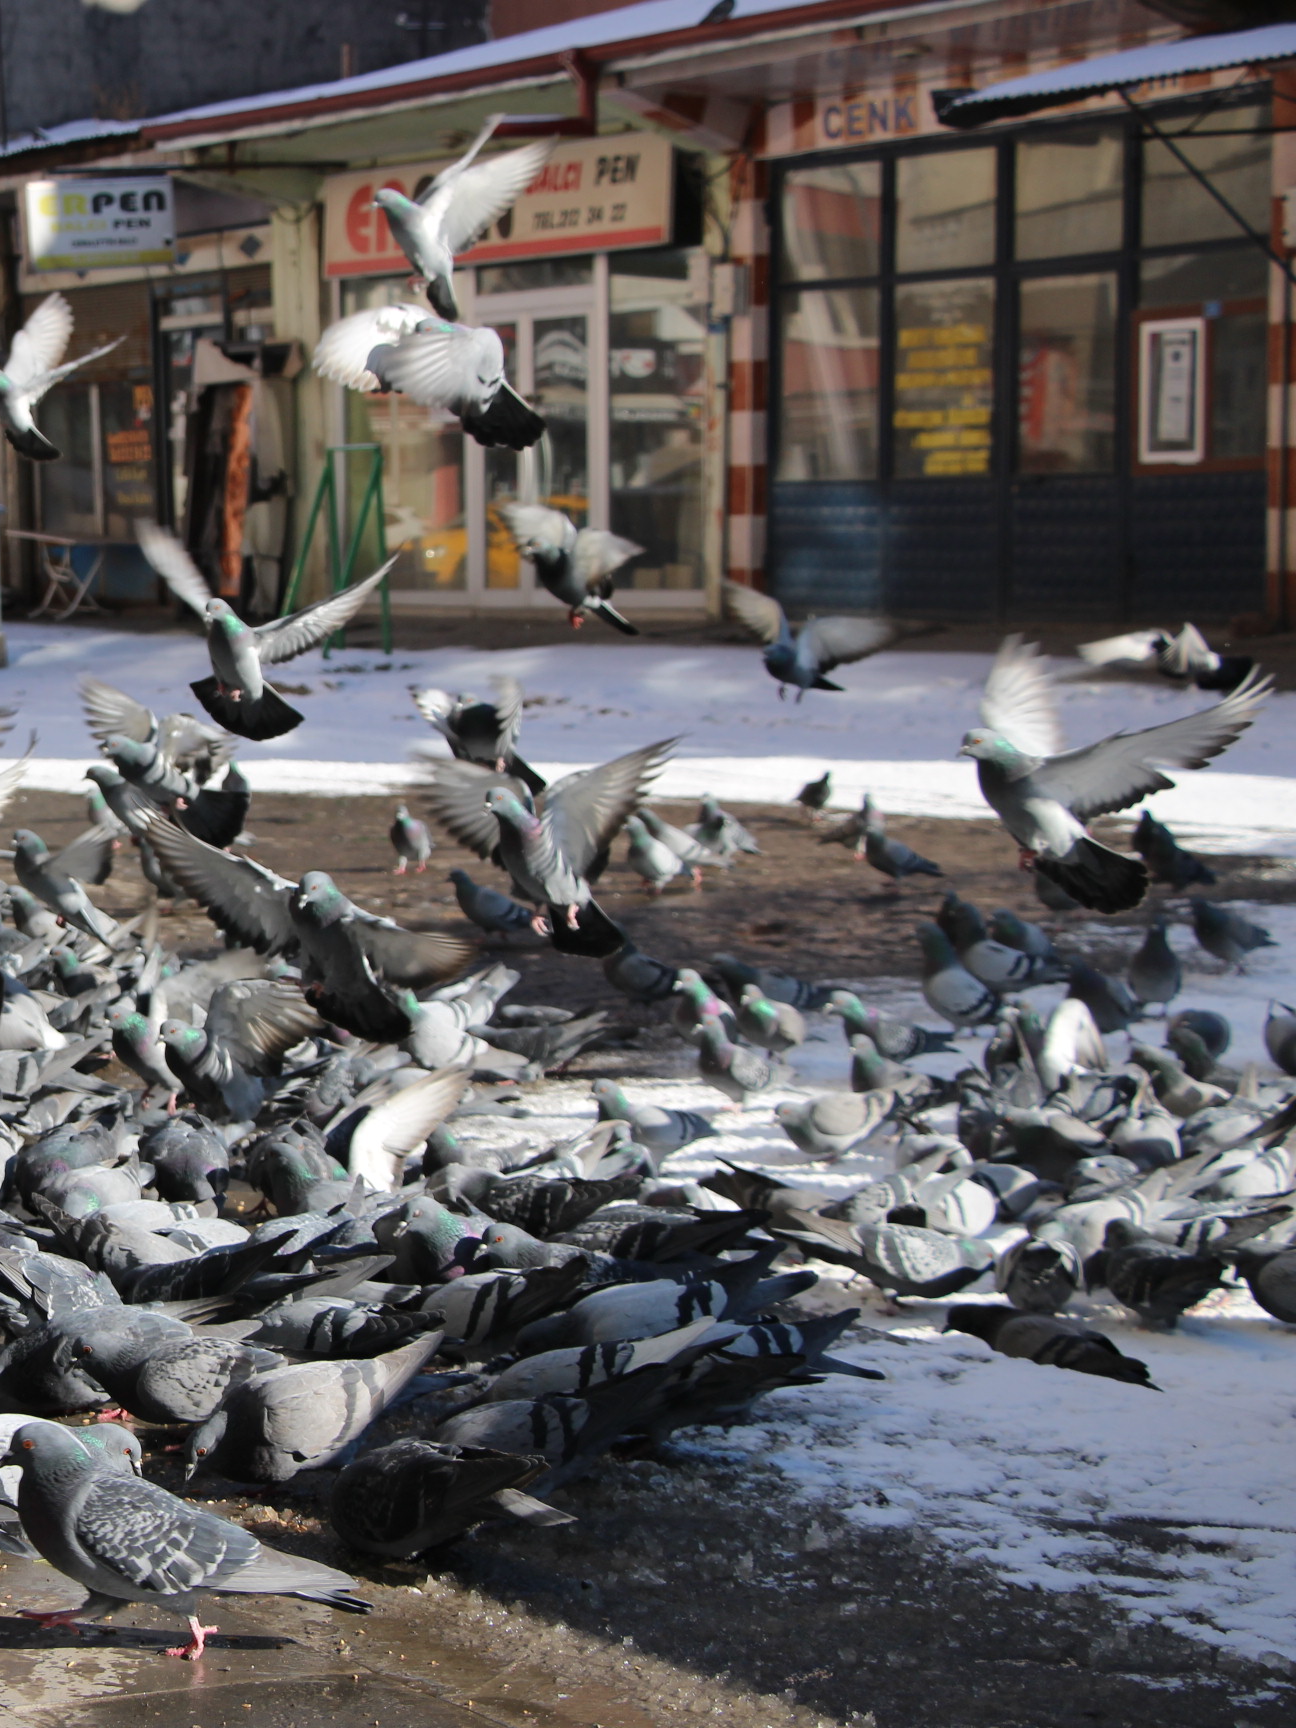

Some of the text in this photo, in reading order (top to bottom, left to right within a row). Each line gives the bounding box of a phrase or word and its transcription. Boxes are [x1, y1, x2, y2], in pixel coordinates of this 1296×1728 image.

[822, 95, 918, 140] CENK
[595, 152, 641, 186] PEN
[39, 188, 167, 216] ERPEN
[113, 216, 152, 230] PEN
